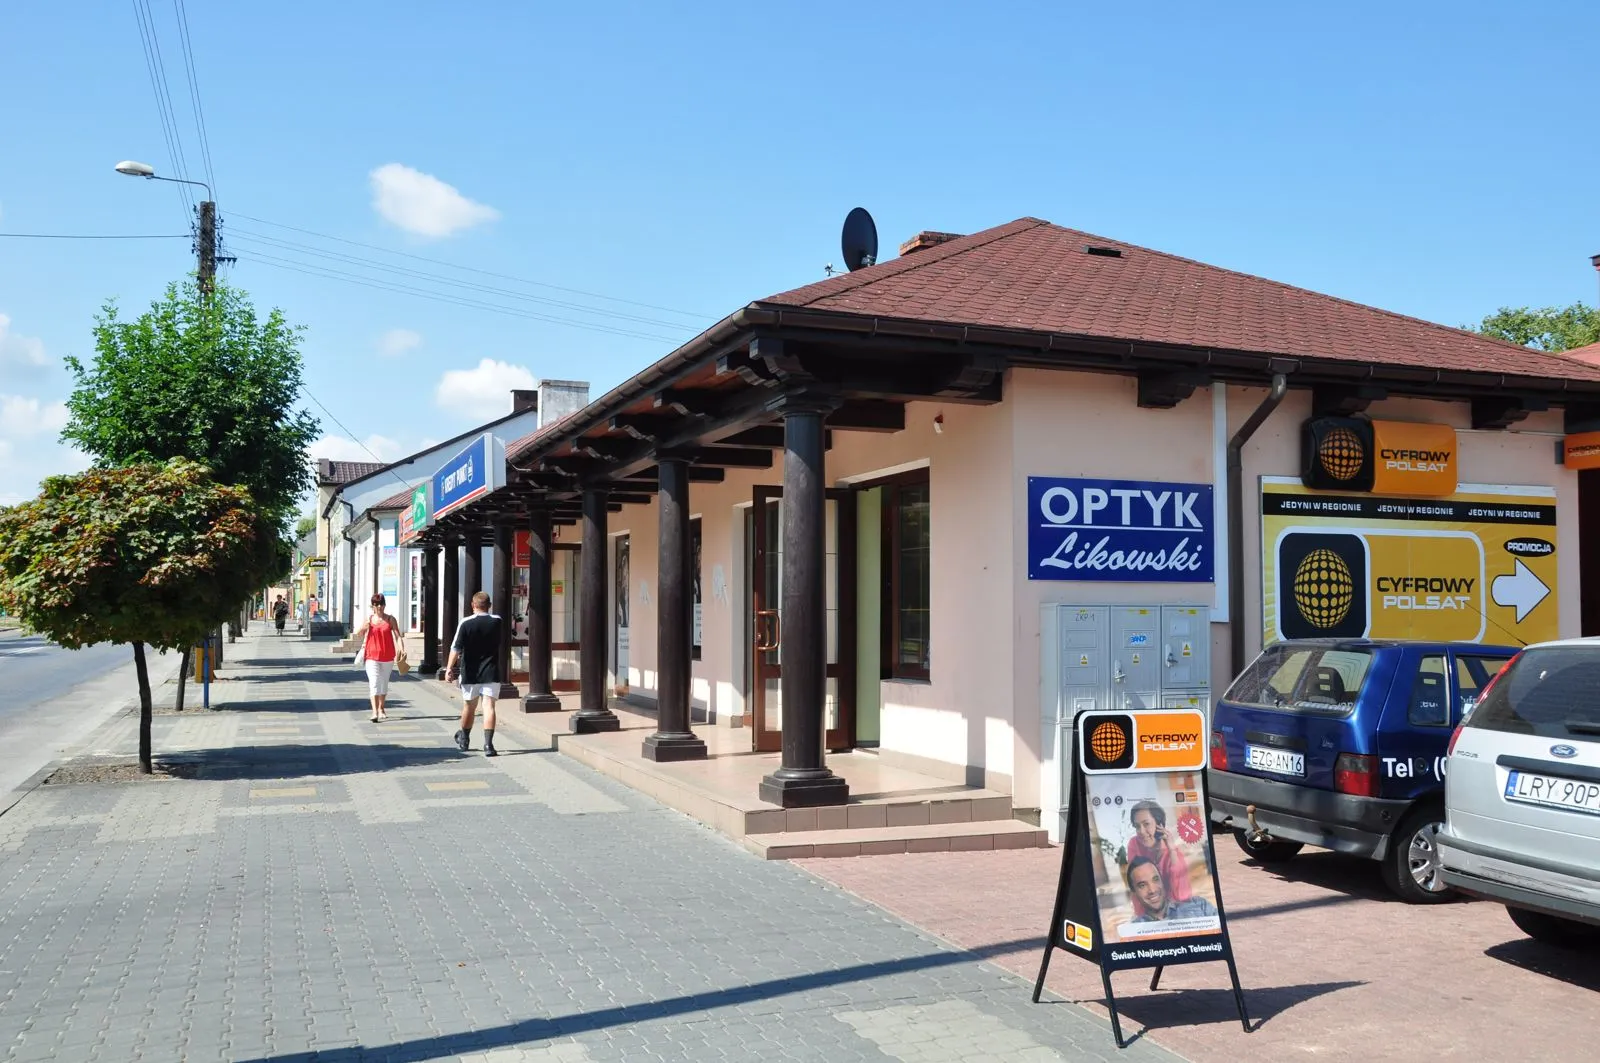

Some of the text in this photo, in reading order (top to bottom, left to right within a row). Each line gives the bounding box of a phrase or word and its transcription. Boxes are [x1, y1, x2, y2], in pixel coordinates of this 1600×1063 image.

[1380, 449, 1450, 462] CYFROWY
[1386, 461, 1447, 473] POLSAT
[1040, 486, 1203, 528] OPTYK
[1280, 500, 1362, 511] JEDYNI W REGIONIE
[1377, 505, 1453, 515] JEDYNI W REGIONIE
[1468, 508, 1496, 517] JEDYNI
[1505, 510, 1541, 519] REGIONIE
[1040, 531, 1203, 571] Likowski
[1507, 541, 1552, 553] PROMOCJA
[1376, 576, 1475, 593] CYFROWY
[1383, 595, 1471, 610] POLSAT
[1139, 733, 1199, 743] CYFROWY
[1143, 742, 1196, 752] POLSAT
[1251, 749, 1303, 772] EZG AN16
[1382, 757, 1414, 778] Tel
[1518, 775, 1558, 799] LRY
[1111, 942, 1223, 961] Świat Najlepszych Telewizji
